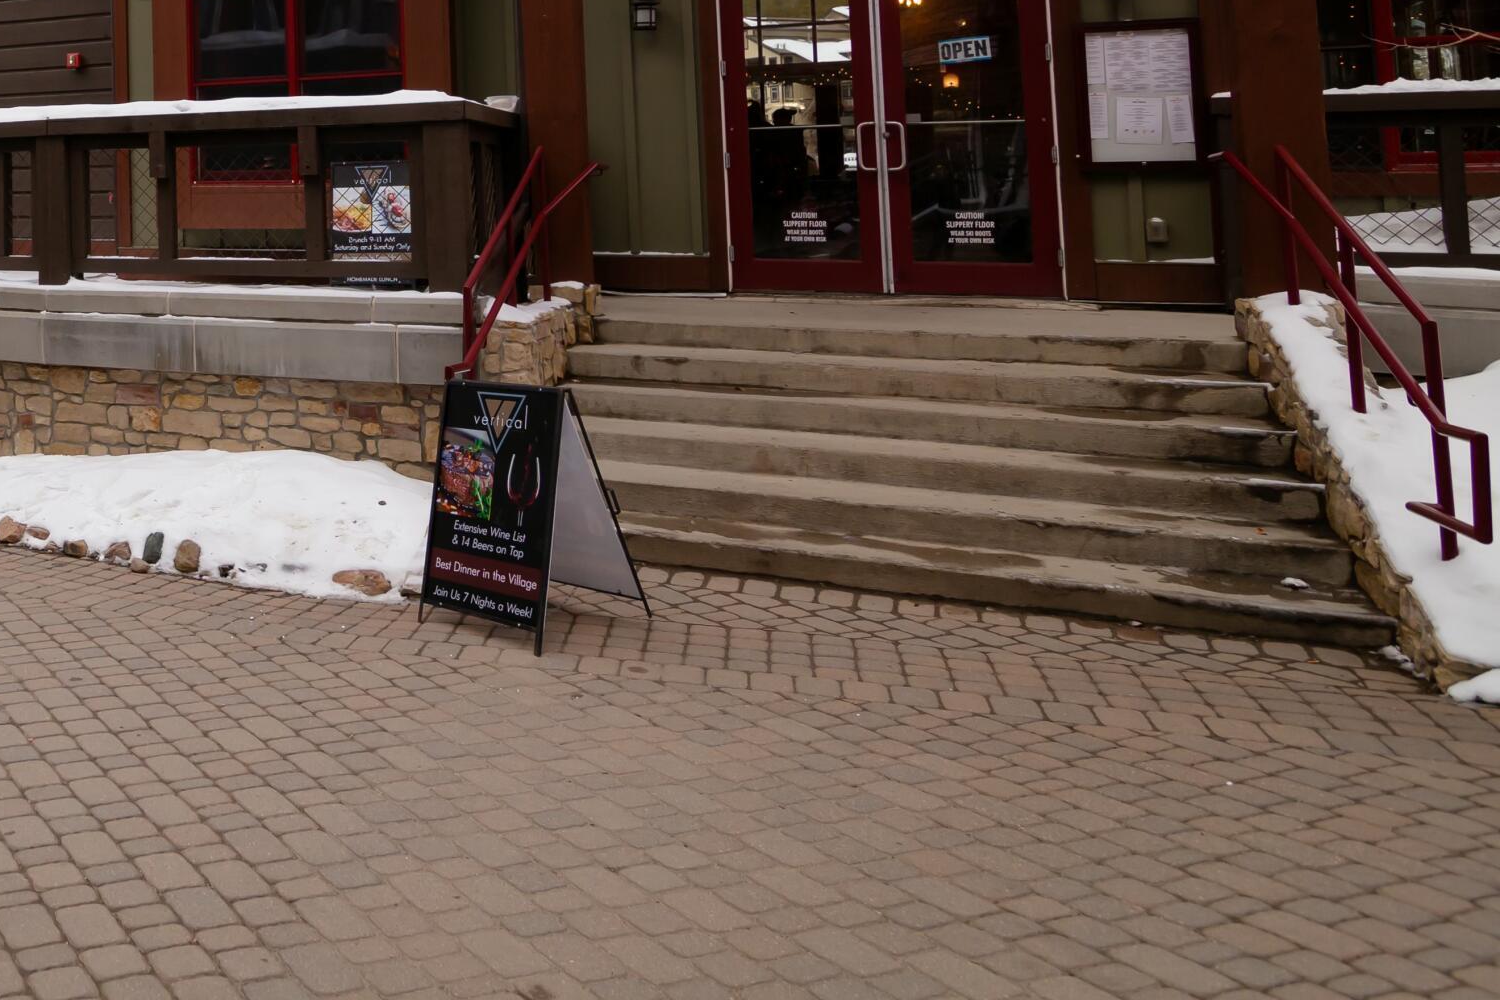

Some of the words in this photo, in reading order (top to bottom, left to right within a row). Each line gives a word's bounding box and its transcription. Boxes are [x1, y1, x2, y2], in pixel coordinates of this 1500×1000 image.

[940, 39, 988, 60] OPEN
[945, 220, 974, 228] SLIPPERY
[955, 211, 985, 219] CAUTION!
[473, 404, 529, 431] vertical
[453, 519, 488, 536] Extensive
[490, 526, 511, 541] Wine
[512, 531, 527, 543] List
[451, 534, 458, 545] &
[461, 535, 471, 547] 14
[472, 538, 494, 552] Beers
[496, 546, 507, 555] on
[510, 545, 524, 560] Tap
[435, 557, 451, 570] Best
[453, 561, 481, 577] Dinner
[482, 568, 491, 580] in
[492, 569, 506, 583] the
[508, 573, 538, 592] Village
[432, 585, 449, 598] Join
[450, 589, 461, 601] Us
[462, 592, 470, 602] 7
[470, 594, 496, 610] Nights
[497, 603, 504, 612] a
[506, 602, 533, 619] Week!
